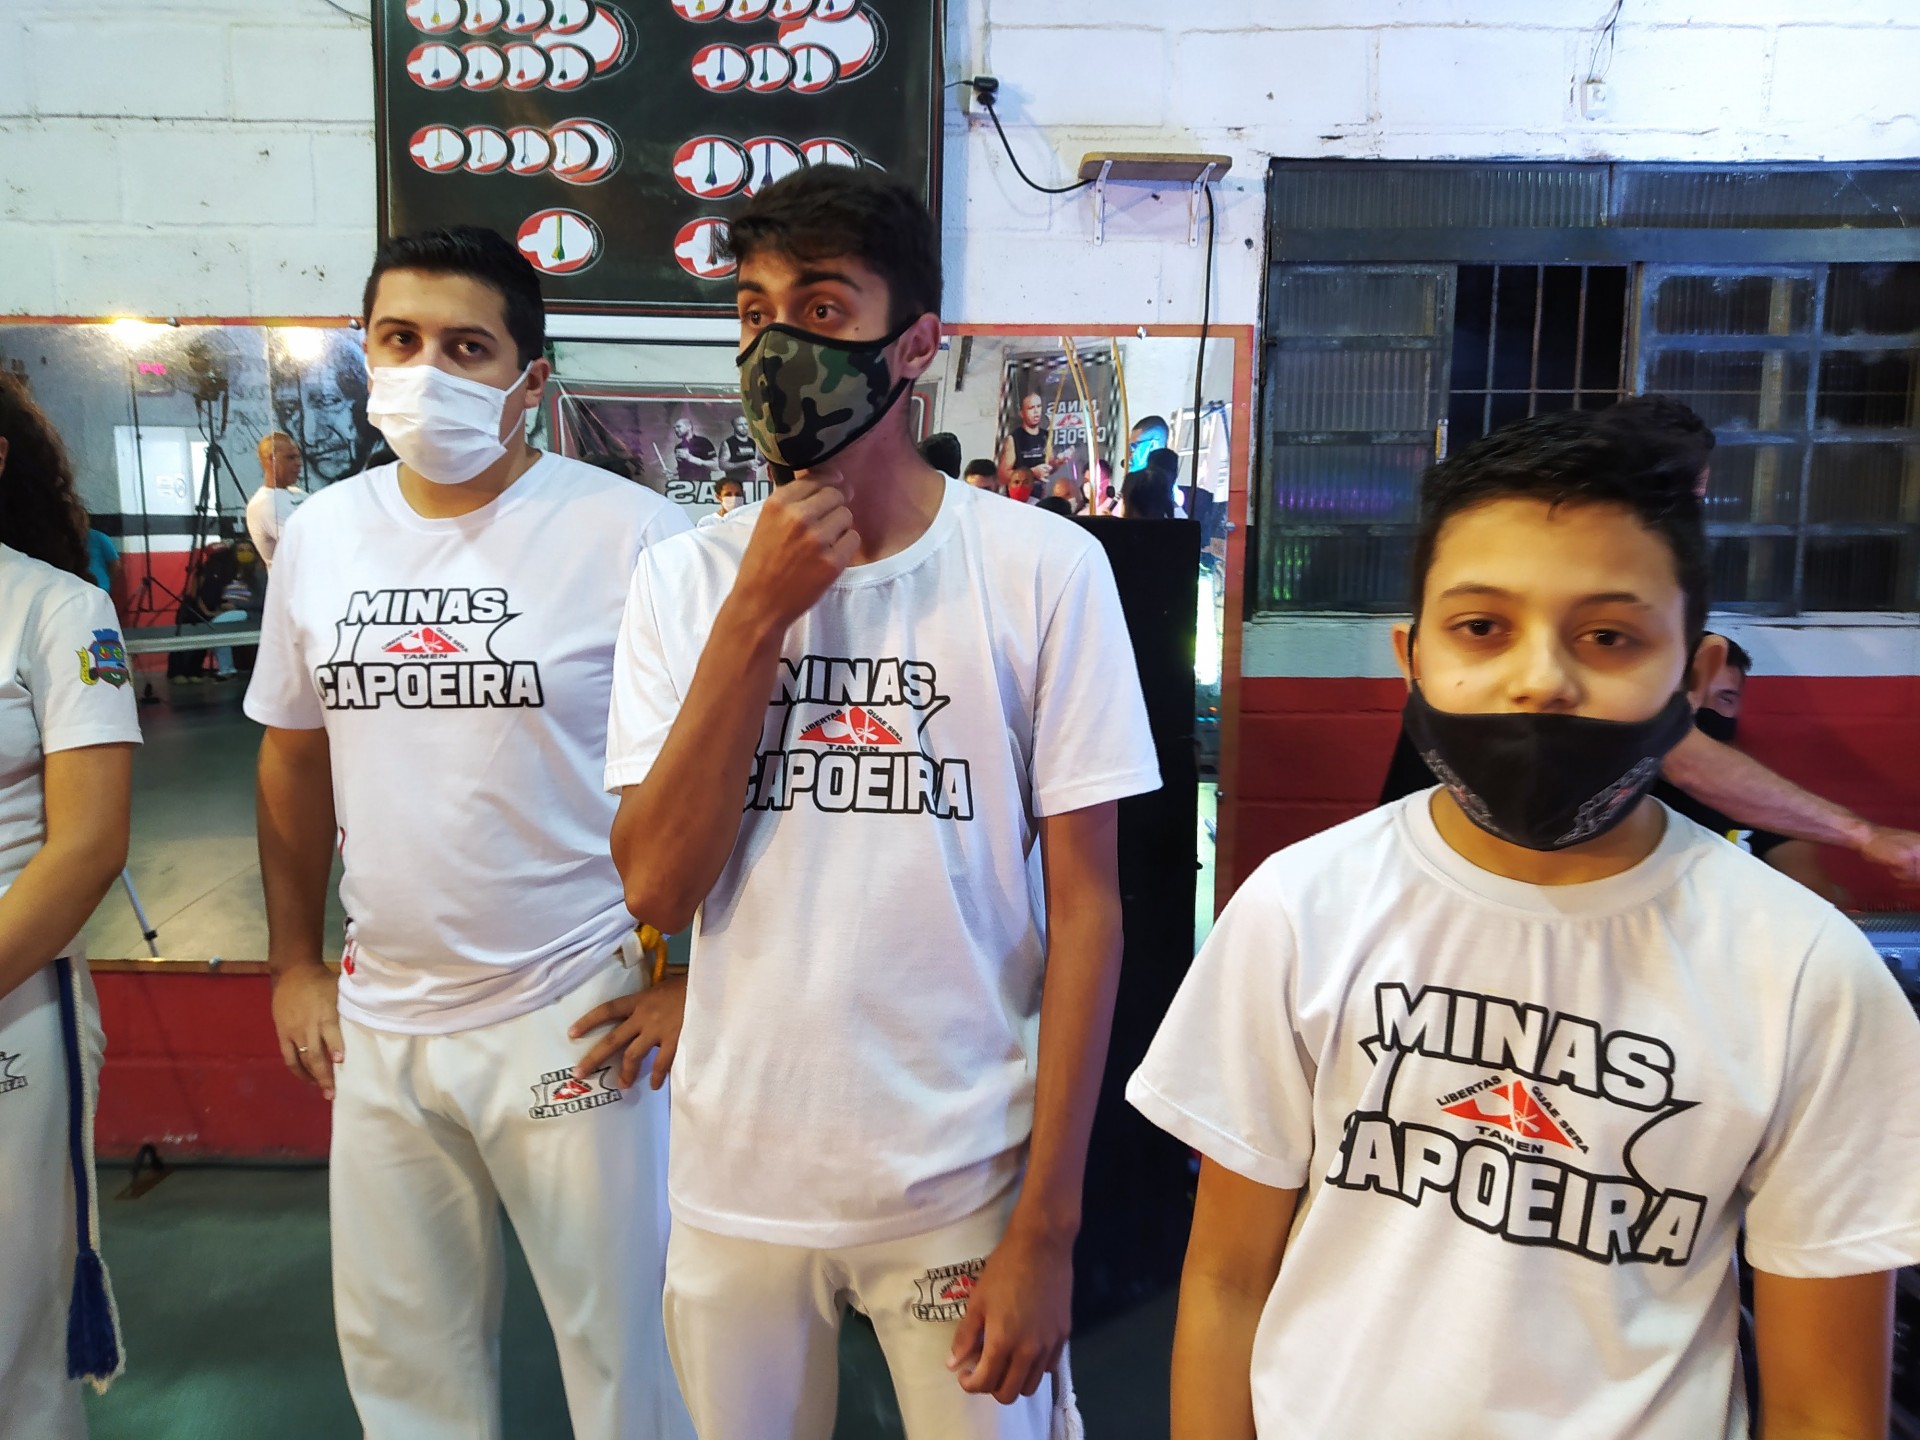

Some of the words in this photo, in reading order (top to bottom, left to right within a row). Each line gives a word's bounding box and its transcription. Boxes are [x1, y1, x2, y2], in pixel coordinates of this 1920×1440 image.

[344, 587, 509, 625] MINAS
[314, 660, 545, 709] CAPOEIRA
[801, 709, 843, 734] LIBERTAS
[867, 708, 888, 727] QUAE
[886, 725, 903, 743] SERA
[826, 743, 880, 752] TAMEN
[1375, 982, 1675, 1111] MINAS
[529, 1089, 623, 1119] CAPOEIRA
[1436, 1075, 1502, 1106] LIBERTAS
[1531, 1086, 1561, 1118] QUAE
[1559, 1119, 1590, 1155] SERA
[1475, 1125, 1544, 1154] TAMEN
[927, 1257, 987, 1281] MINA
